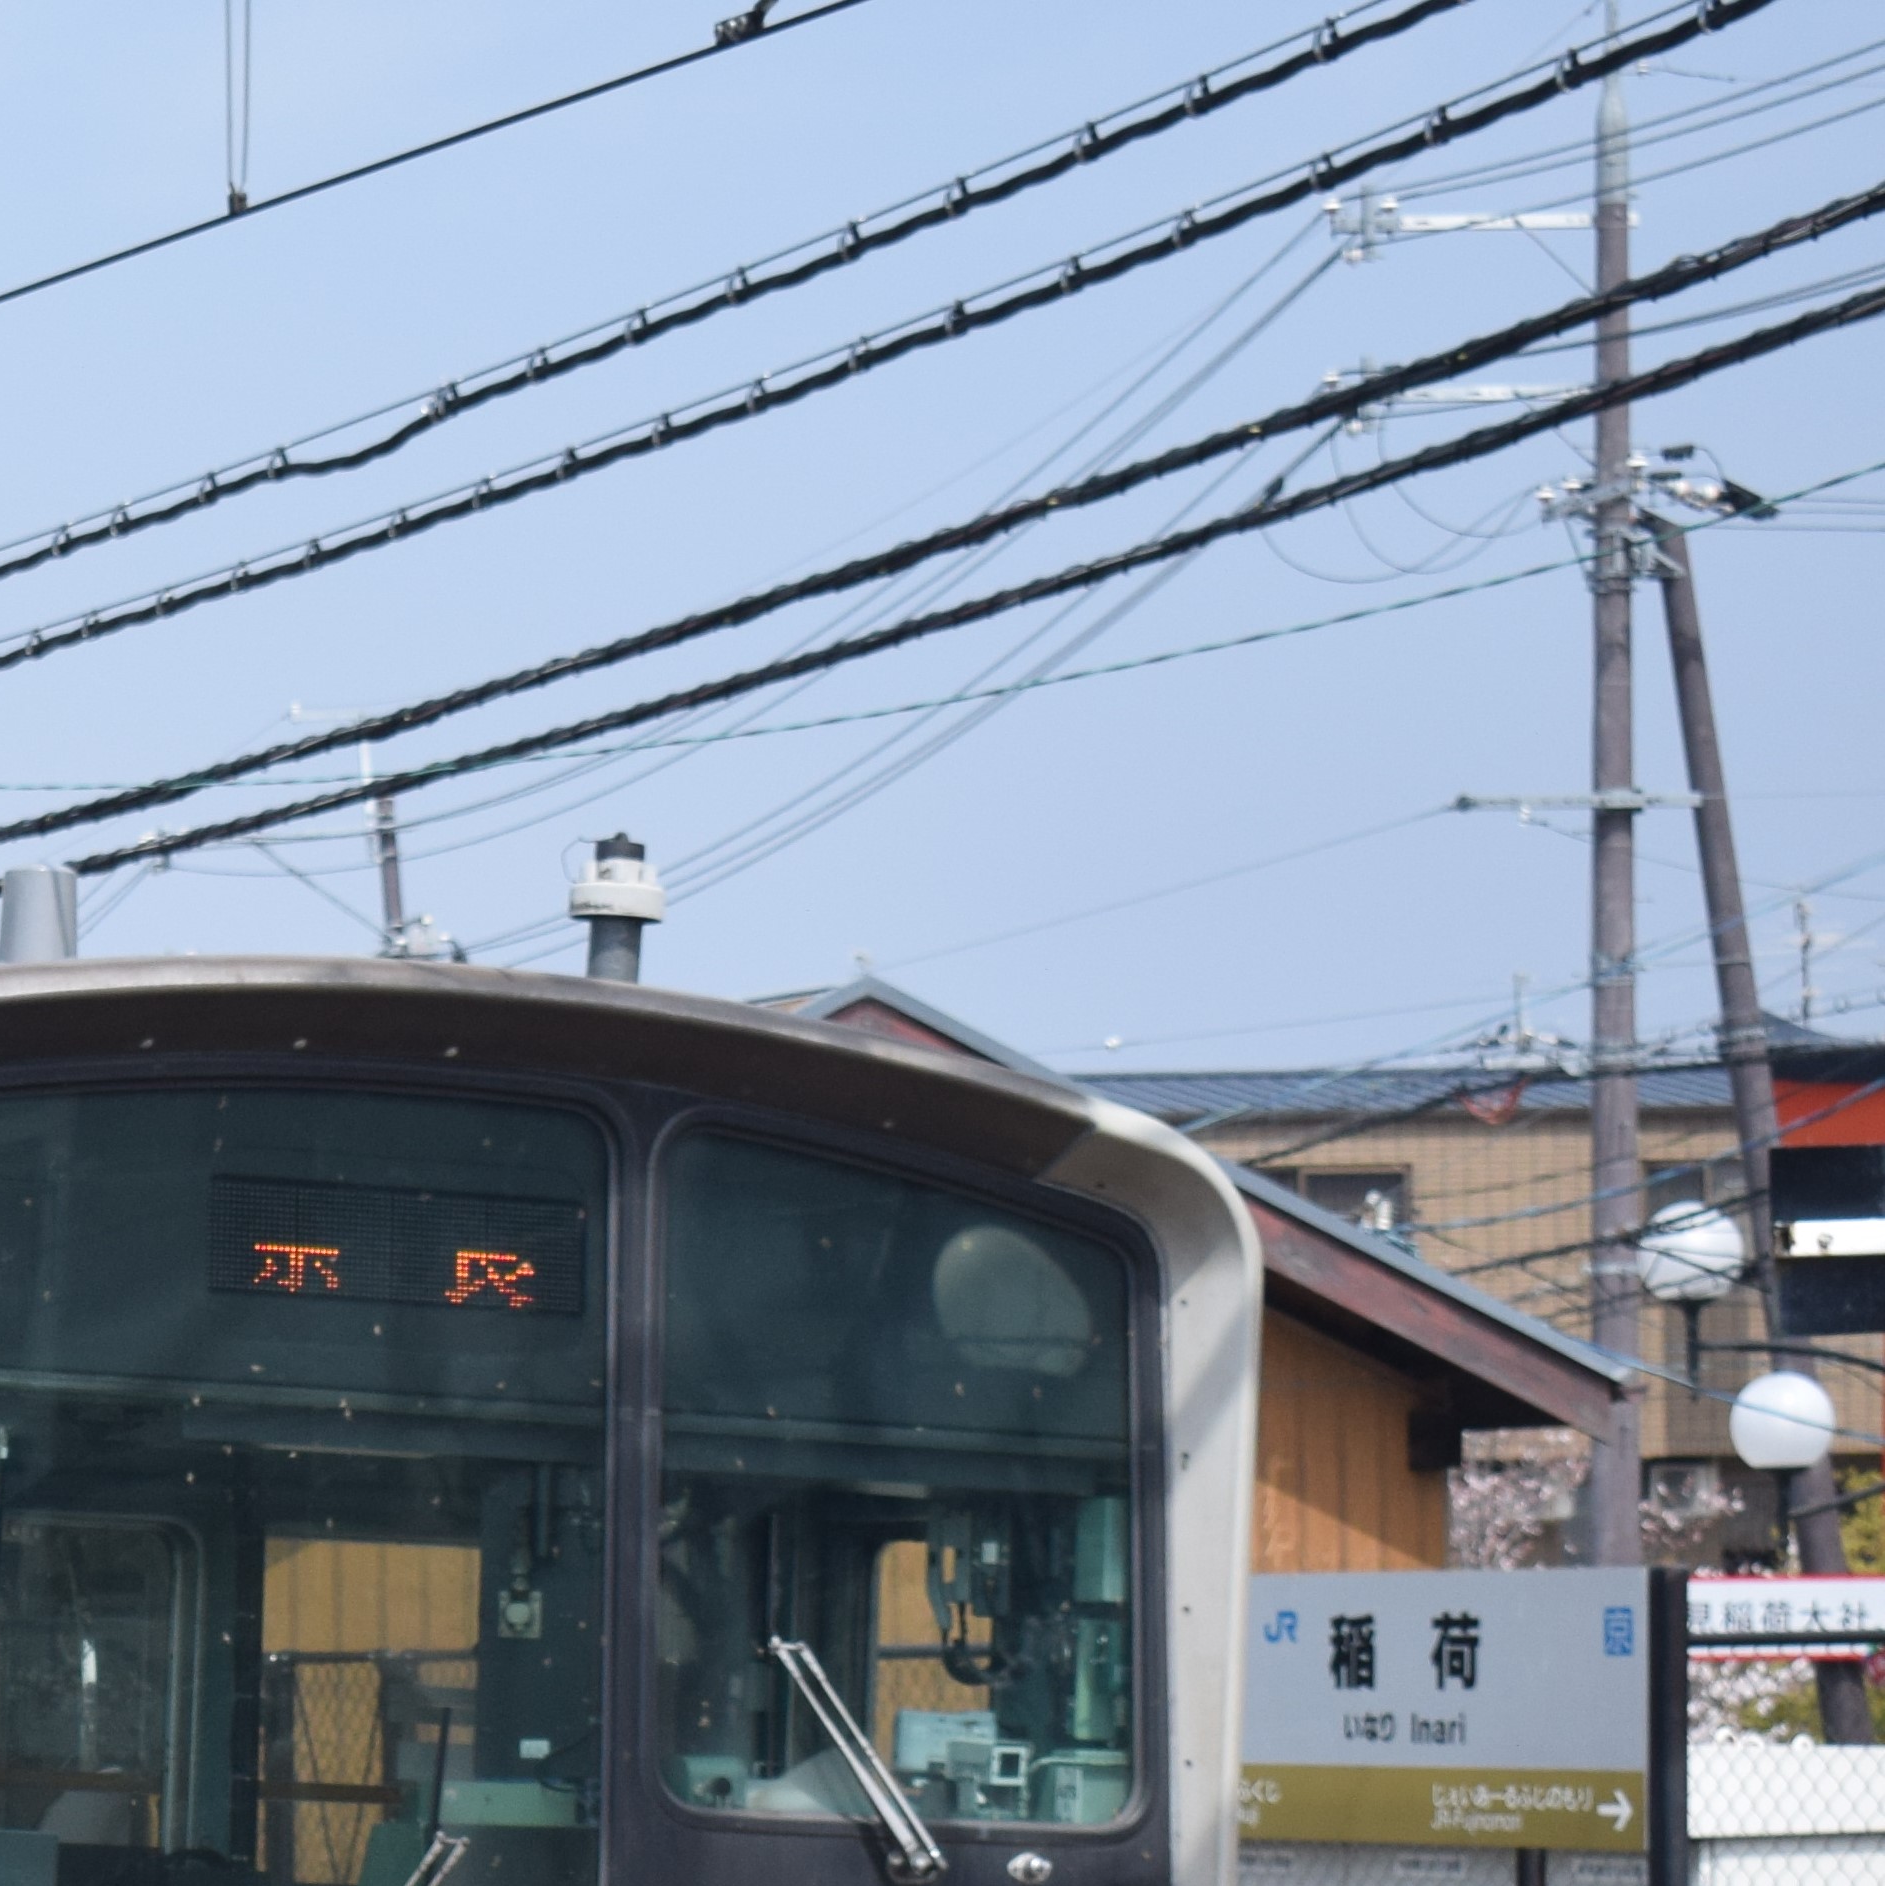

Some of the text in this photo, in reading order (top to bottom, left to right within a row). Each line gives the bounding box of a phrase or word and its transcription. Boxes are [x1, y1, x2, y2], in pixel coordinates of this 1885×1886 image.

[1263, 1609, 1299, 1645] JR
[1327, 1610, 1482, 1691] 稲荷
[1342, 1711, 1467, 1745] いなり Inari
